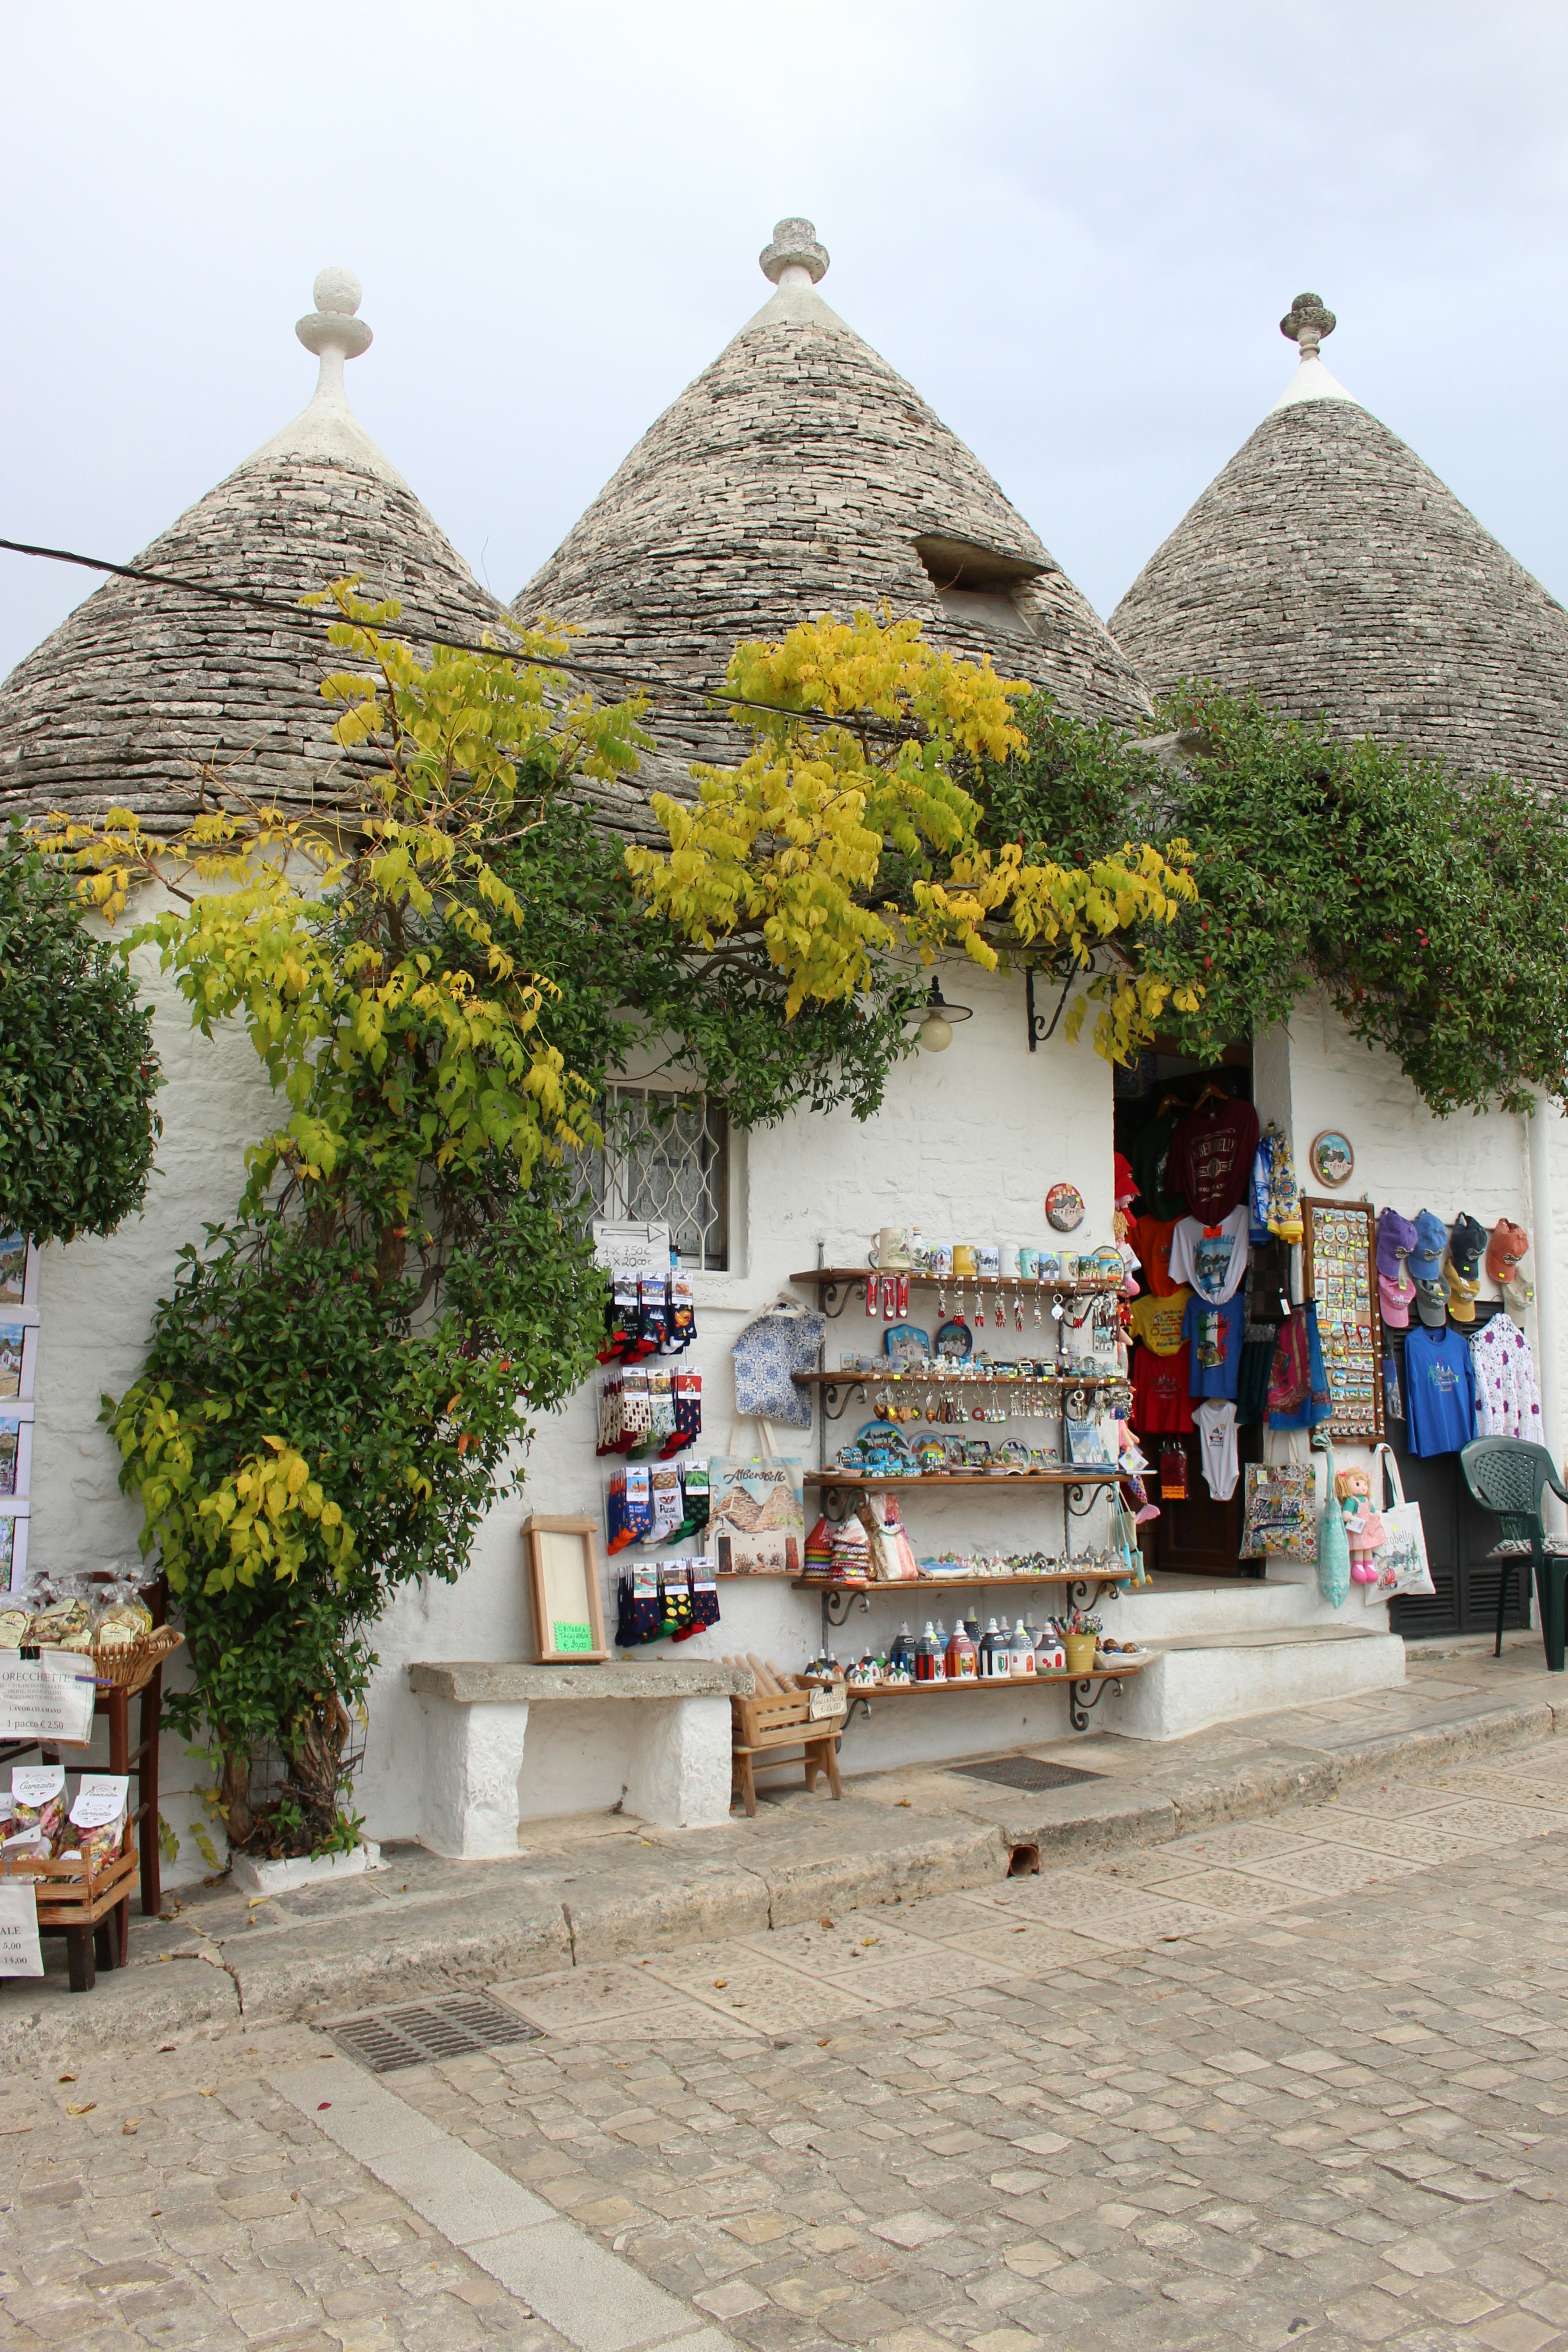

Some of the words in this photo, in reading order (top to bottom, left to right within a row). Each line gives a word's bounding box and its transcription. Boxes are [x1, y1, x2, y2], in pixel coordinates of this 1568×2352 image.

[723, 1469, 786, 1484] Alberobello
[660, 1504, 676, 1513] Pizza
[2, 1672, 70, 1682] ORECCHIETTE
[15, 1721, 38, 1729] pacco
[48, 1721, 64, 1729] 2,50
[20, 1781, 56, 1790] Carazita
